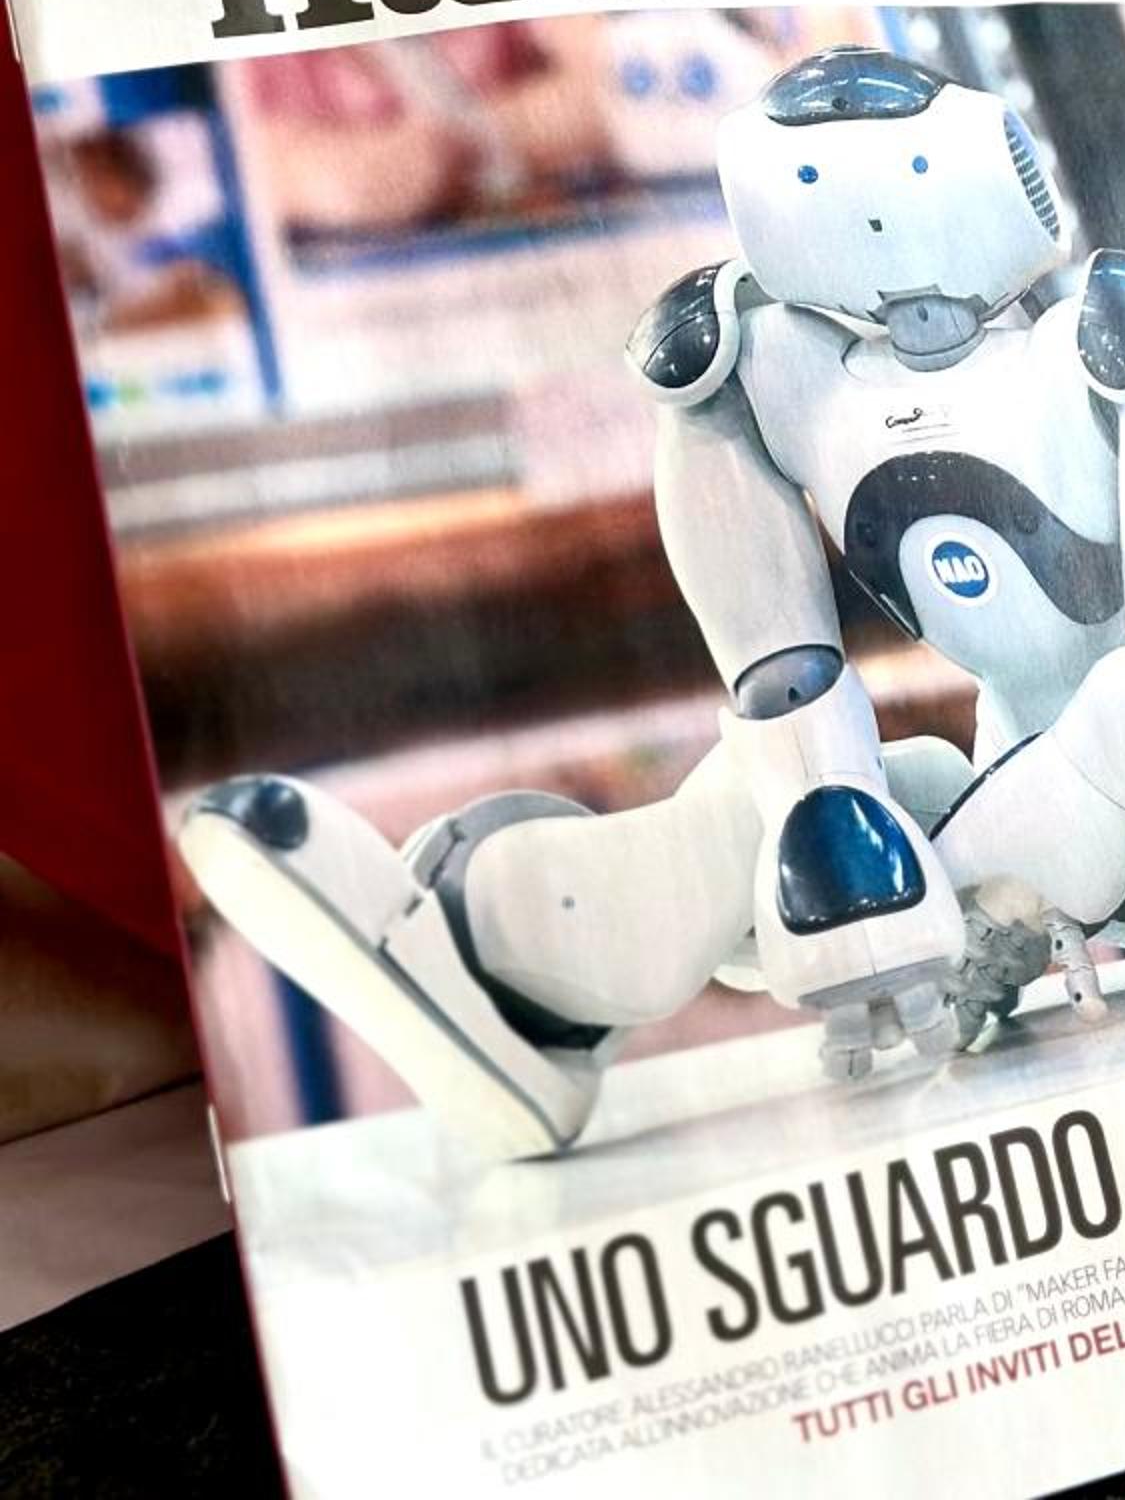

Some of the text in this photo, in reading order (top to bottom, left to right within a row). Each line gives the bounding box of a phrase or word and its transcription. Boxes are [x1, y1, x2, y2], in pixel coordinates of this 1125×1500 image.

[933, 554, 987, 585] NAO
[459, 1232, 673, 1407] UNO
[690, 1106, 1122, 1343] SGUARDO
[501, 1440, 615, 1488] DEDICATA
[620, 1378, 809, 1451] ALL'INNOVAZIONE
[865, 1340, 937, 1378] ANIMA
[939, 1332, 973, 1357] LA
[975, 1313, 1034, 1350] FIERA
[1037, 1305, 1058, 1330] DI
[504, 1401, 629, 1455] CURATORE
[631, 1355, 781, 1419] ALESSANDRO
[783, 1315, 916, 1375] RANELLUCCI
[920, 1298, 990, 1336] PARLA
[992, 1289, 1014, 1315] DI
[1017, 1263, 1101, 1303] "MAKER
[792, 1388, 894, 1443] TUTTI
[901, 1369, 960, 1412] GLI
[965, 1340, 1062, 1394] INVITI
